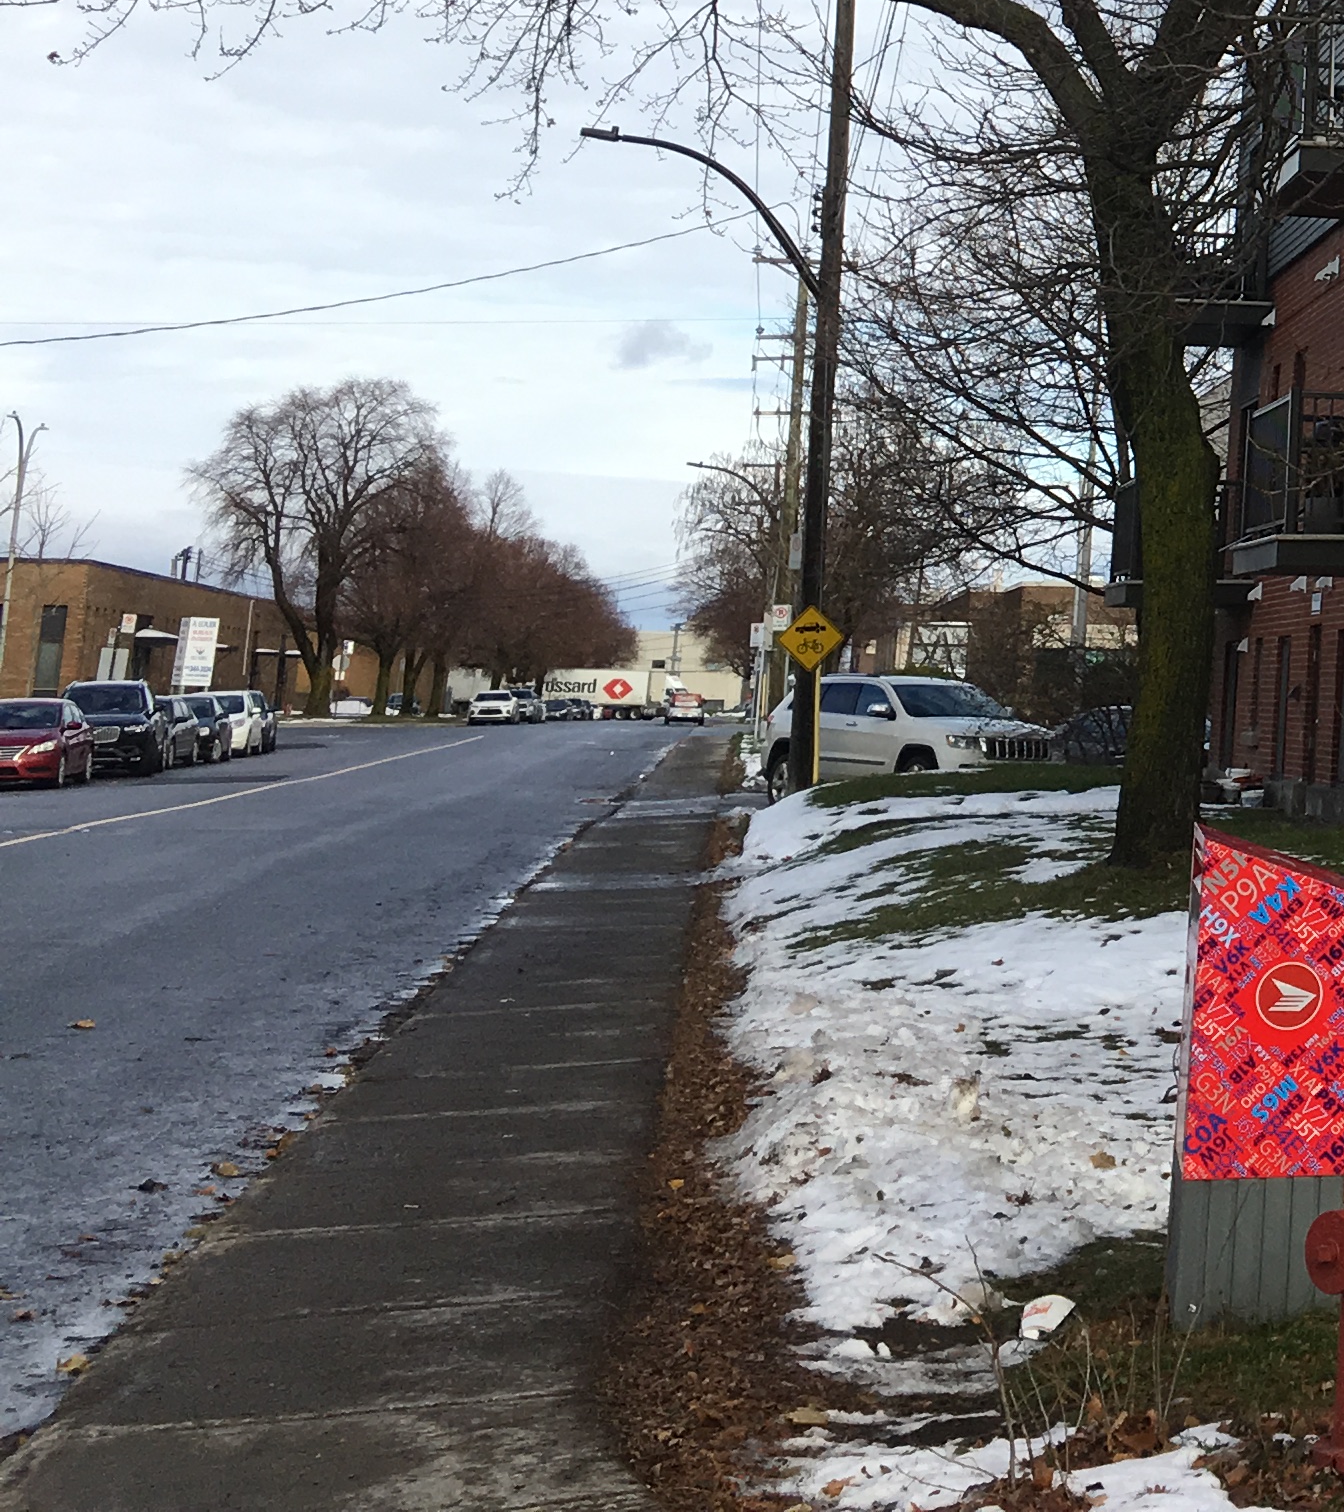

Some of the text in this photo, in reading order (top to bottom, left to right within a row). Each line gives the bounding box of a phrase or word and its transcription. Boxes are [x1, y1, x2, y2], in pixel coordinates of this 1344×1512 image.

[1220, 864, 1279, 918] P9A
[1247, 875, 1301, 926] K4A
[1200, 904, 1242, 950] H9X
[1292, 922, 1320, 945] J5T
[1302, 899, 1334, 936] V7J
[1213, 939, 1251, 975] V6K
[1198, 1018, 1227, 1042] J5T
[1206, 995, 1240, 1032] V7J
[1215, 1025, 1249, 1052] V9L
[1229, 1053, 1256, 1085] A1B
[1253, 1063, 1277, 1089] P9A
[1288, 1061, 1318, 1093] X1A
[1196, 1072, 1238, 1115] G3N
[1250, 1074, 1299, 1124] M6S
[1292, 1118, 1321, 1143] J5T
[1302, 1095, 1335, 1133] V7J
[1259, 1139, 1292, 1174] G3N
